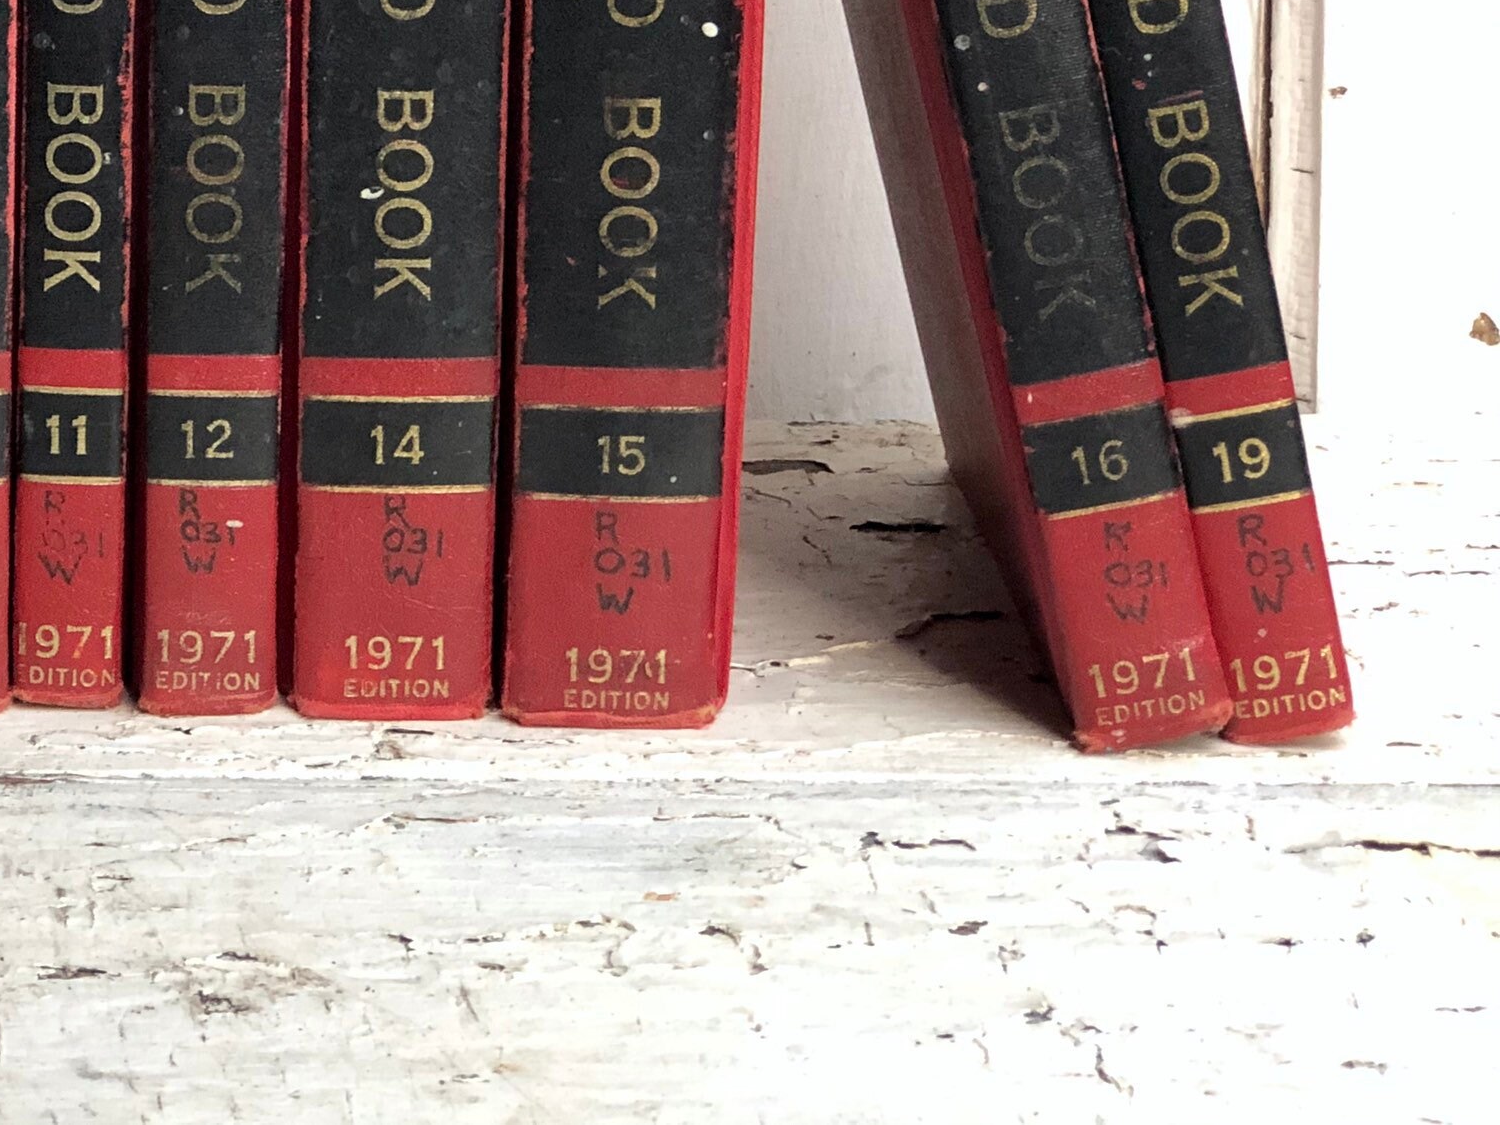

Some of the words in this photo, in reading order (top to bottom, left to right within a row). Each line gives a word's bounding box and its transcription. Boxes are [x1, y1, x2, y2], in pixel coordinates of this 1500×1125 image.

[42, 81, 105, 293] BOOK
[184, 83, 247, 294] BOOK
[373, 87, 435, 302] BOOK
[597, 96, 662, 310] BOOK
[1000, 104, 1096, 321] BOOK
[1147, 99, 1244, 317] BOOK
[45, 414, 89, 456] 11
[180, 419, 235, 460] 12
[369, 424, 425, 466] 14
[597, 434, 647, 476] 15
[1071, 439, 1129, 486] 16
[1212, 437, 1271, 484] 19
[178, 488, 201, 519] R
[1237, 513, 1267, 548] R
[37, 551, 84, 586] W
[181, 544, 217, 575] W
[382, 554, 423, 587] W
[596, 582, 636, 616] W
[1106, 591, 1150, 625] W
[1250, 575, 1290, 614] W
[18, 624, 114, 660] 1971
[156, 629, 256, 666] 1971
[344, 635, 445, 671] 1971
[17, 665, 116, 688] EDITION
[156, 671, 261, 691] EDITION
[565, 647, 667, 685] 1971
[1088, 647, 1197, 699] 1971
[1229, 643, 1339, 693] 1971
[343, 678, 450, 699] EDITION
[564, 689, 670, 711] EDITION
[1236, 684, 1346, 719] EDITION
[1095, 689, 1206, 727] EDITION
